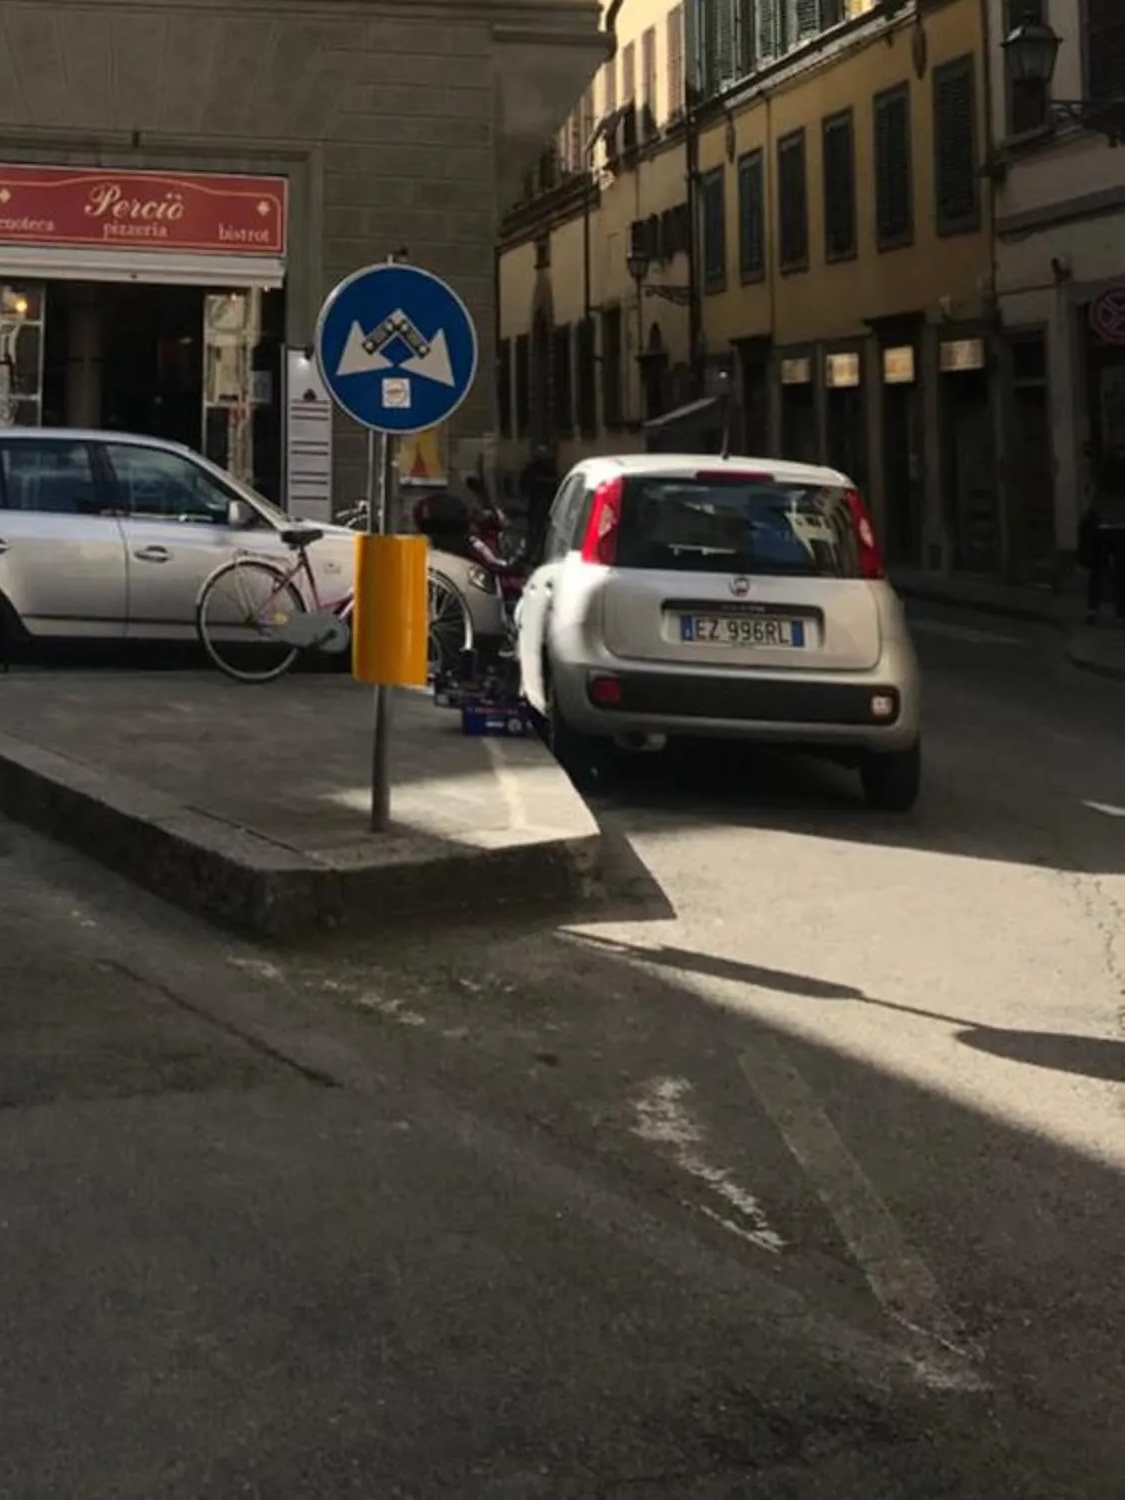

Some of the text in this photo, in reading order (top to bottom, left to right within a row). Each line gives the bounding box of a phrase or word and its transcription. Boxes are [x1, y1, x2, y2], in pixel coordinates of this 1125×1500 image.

[103, 221, 169, 240] pizzeria
[218, 223, 271, 242] bistrot
[695, 617, 790, 644] EZ 996RL
